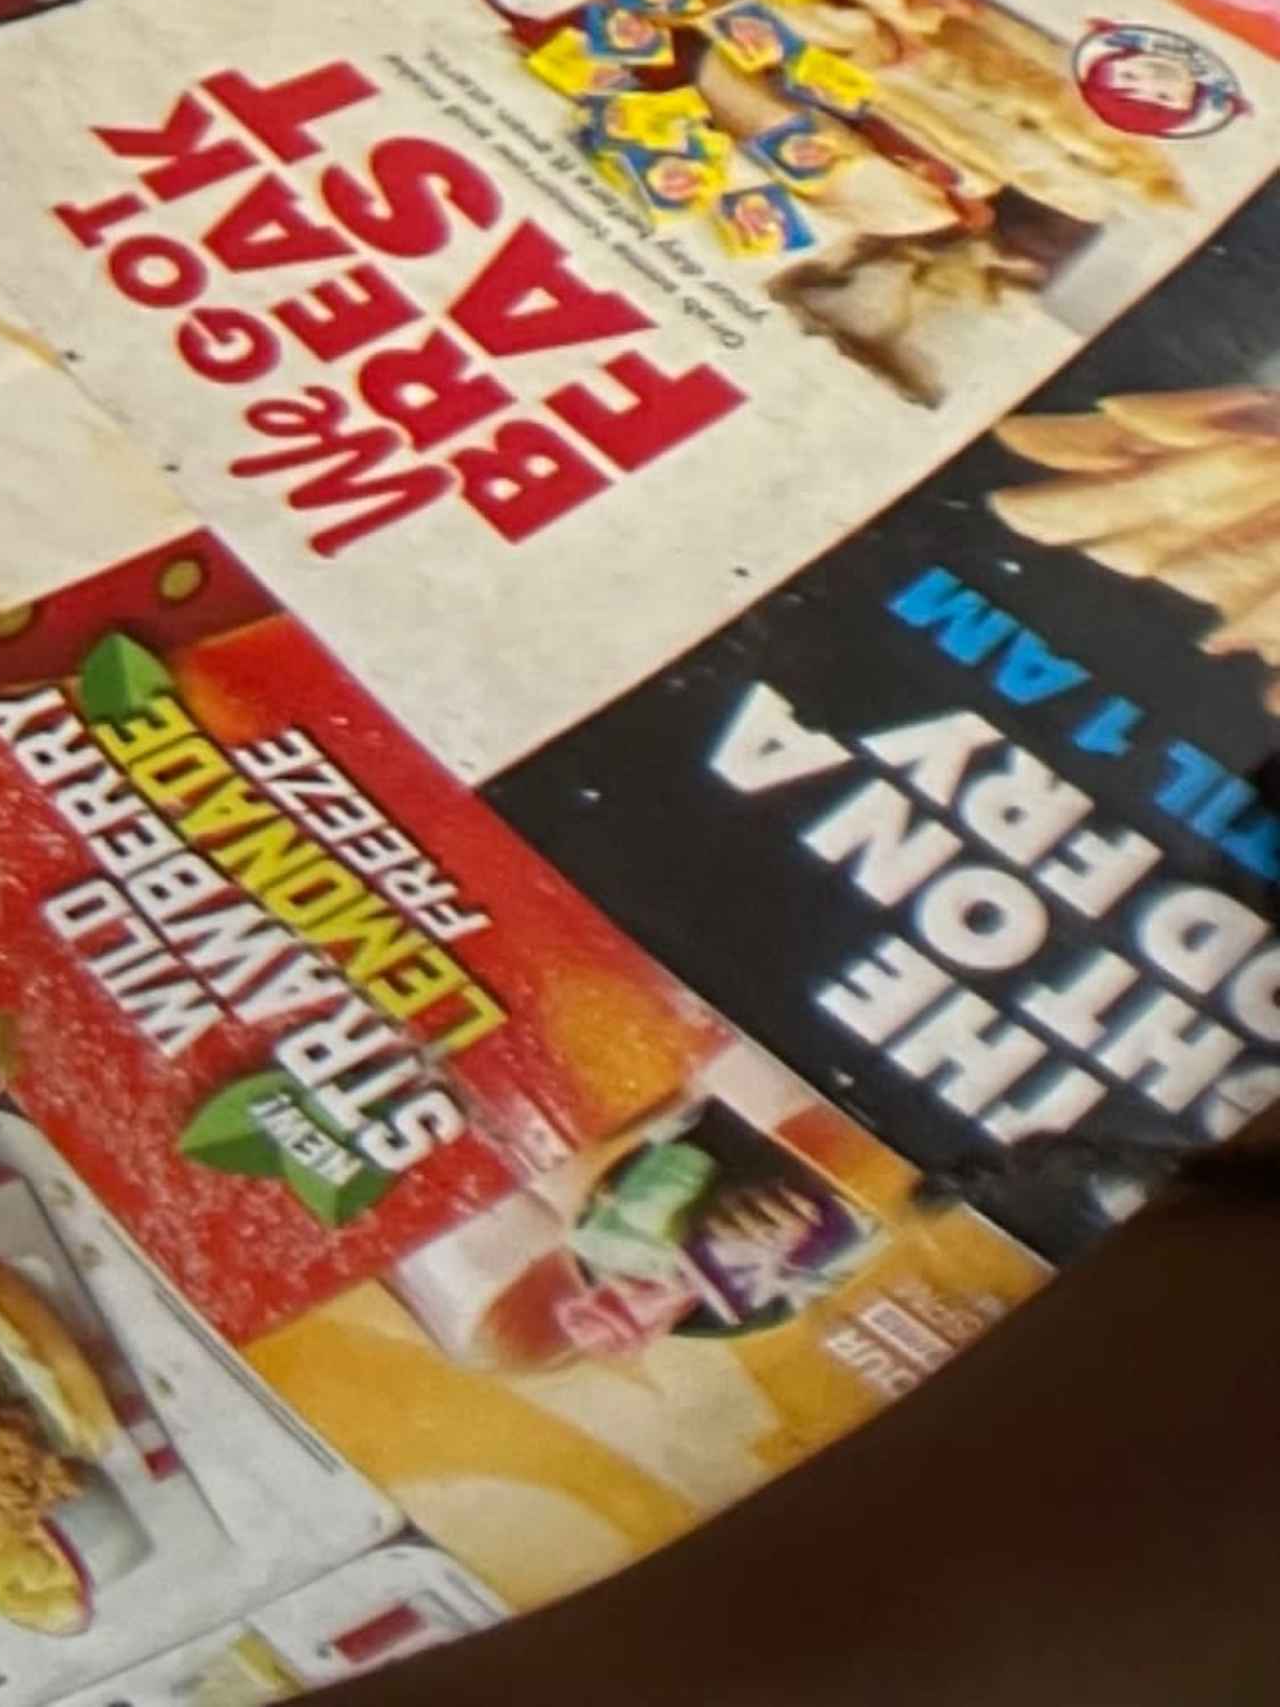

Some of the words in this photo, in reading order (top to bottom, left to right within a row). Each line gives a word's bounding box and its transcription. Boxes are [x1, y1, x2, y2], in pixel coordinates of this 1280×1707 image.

[52, 192, 286, 383] GOT
[90, 65, 616, 545] BREAK
[202, 60, 752, 472] FAST
[228, 388, 443, 555] We
[887, 567, 1091, 705] AM
[1071, 697, 1144, 757] 1
[708, 681, 853, 794] A
[860, 709, 1163, 919] FRY
[94, 688, 507, 1052] LEMONADE
[235, 726, 492, 941] FREEZE
[800, 785, 1047, 972] ON
[43, 881, 220, 1058] WILD
[811, 935, 1111, 1146] THE
[249, 1094, 361, 1188] NEW!
